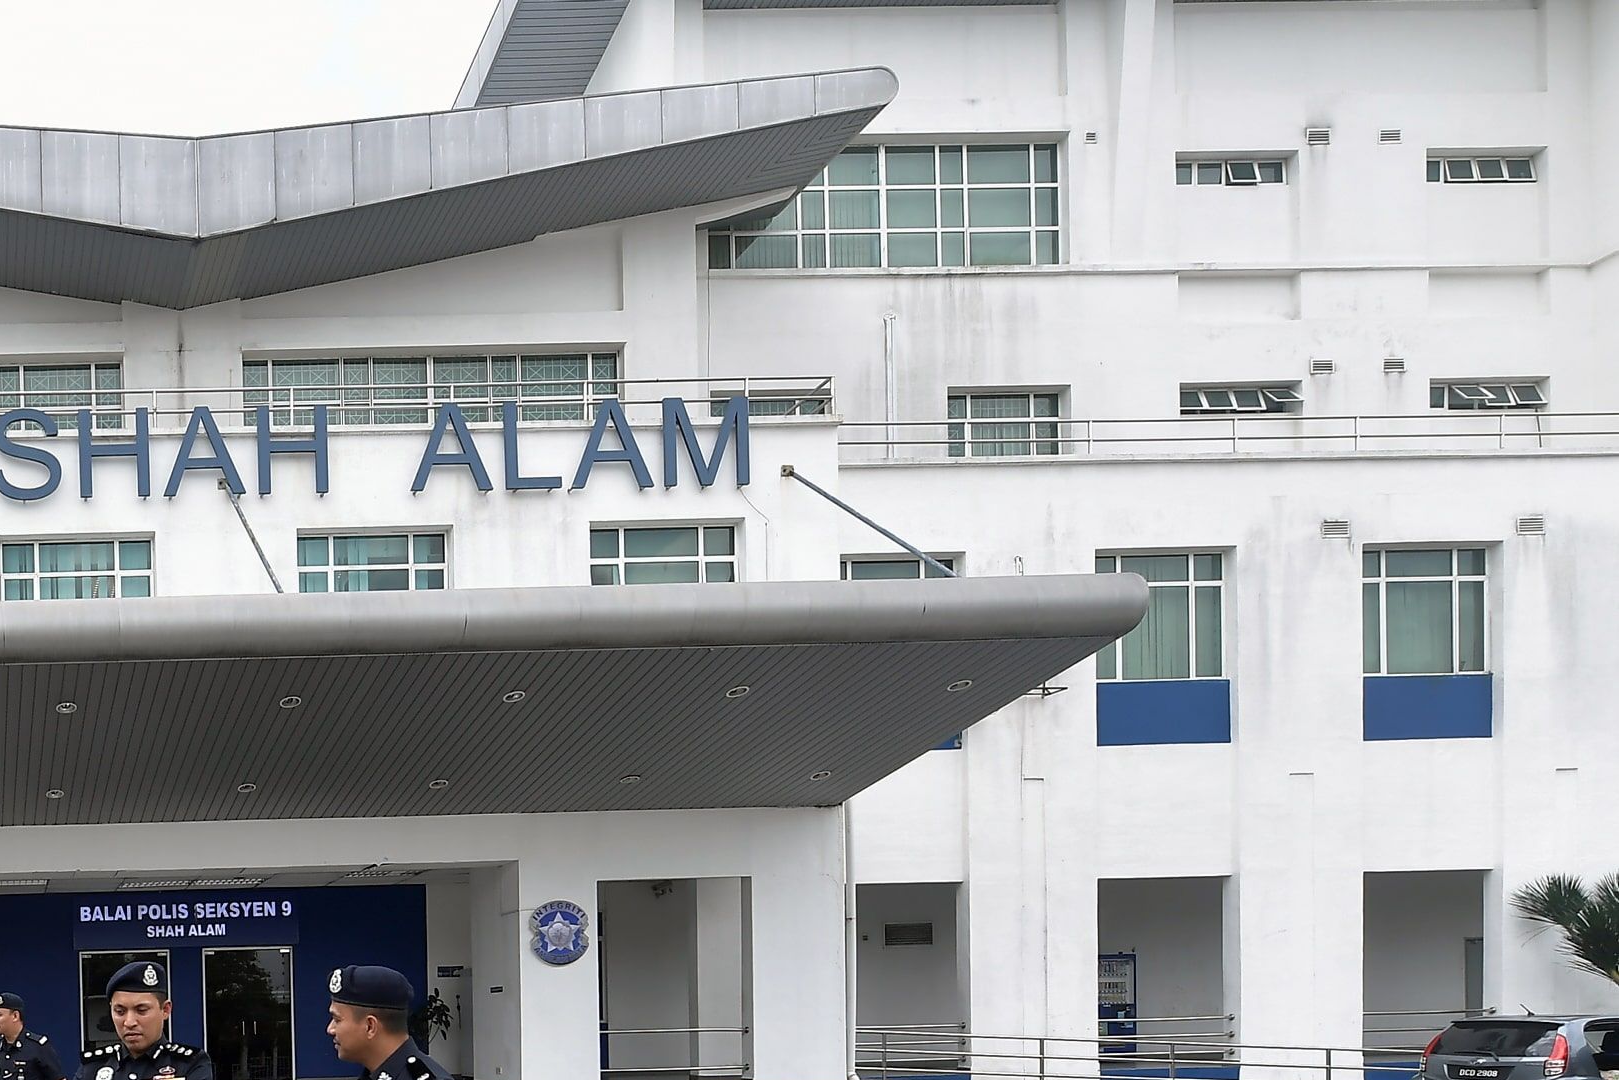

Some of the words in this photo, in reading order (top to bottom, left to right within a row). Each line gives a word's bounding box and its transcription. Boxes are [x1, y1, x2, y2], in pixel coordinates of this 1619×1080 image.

[410, 396, 750, 492] ALAM
[80, 906, 131, 922] BALAI
[137, 904, 189, 920] POLIS
[196, 902, 276, 919] SEKSYEN
[281, 901, 292, 917] 9
[532, 902, 586, 921] INTEGRITI
[147, 925, 184, 938] SHAH
[188, 923, 226, 937] ALAM
